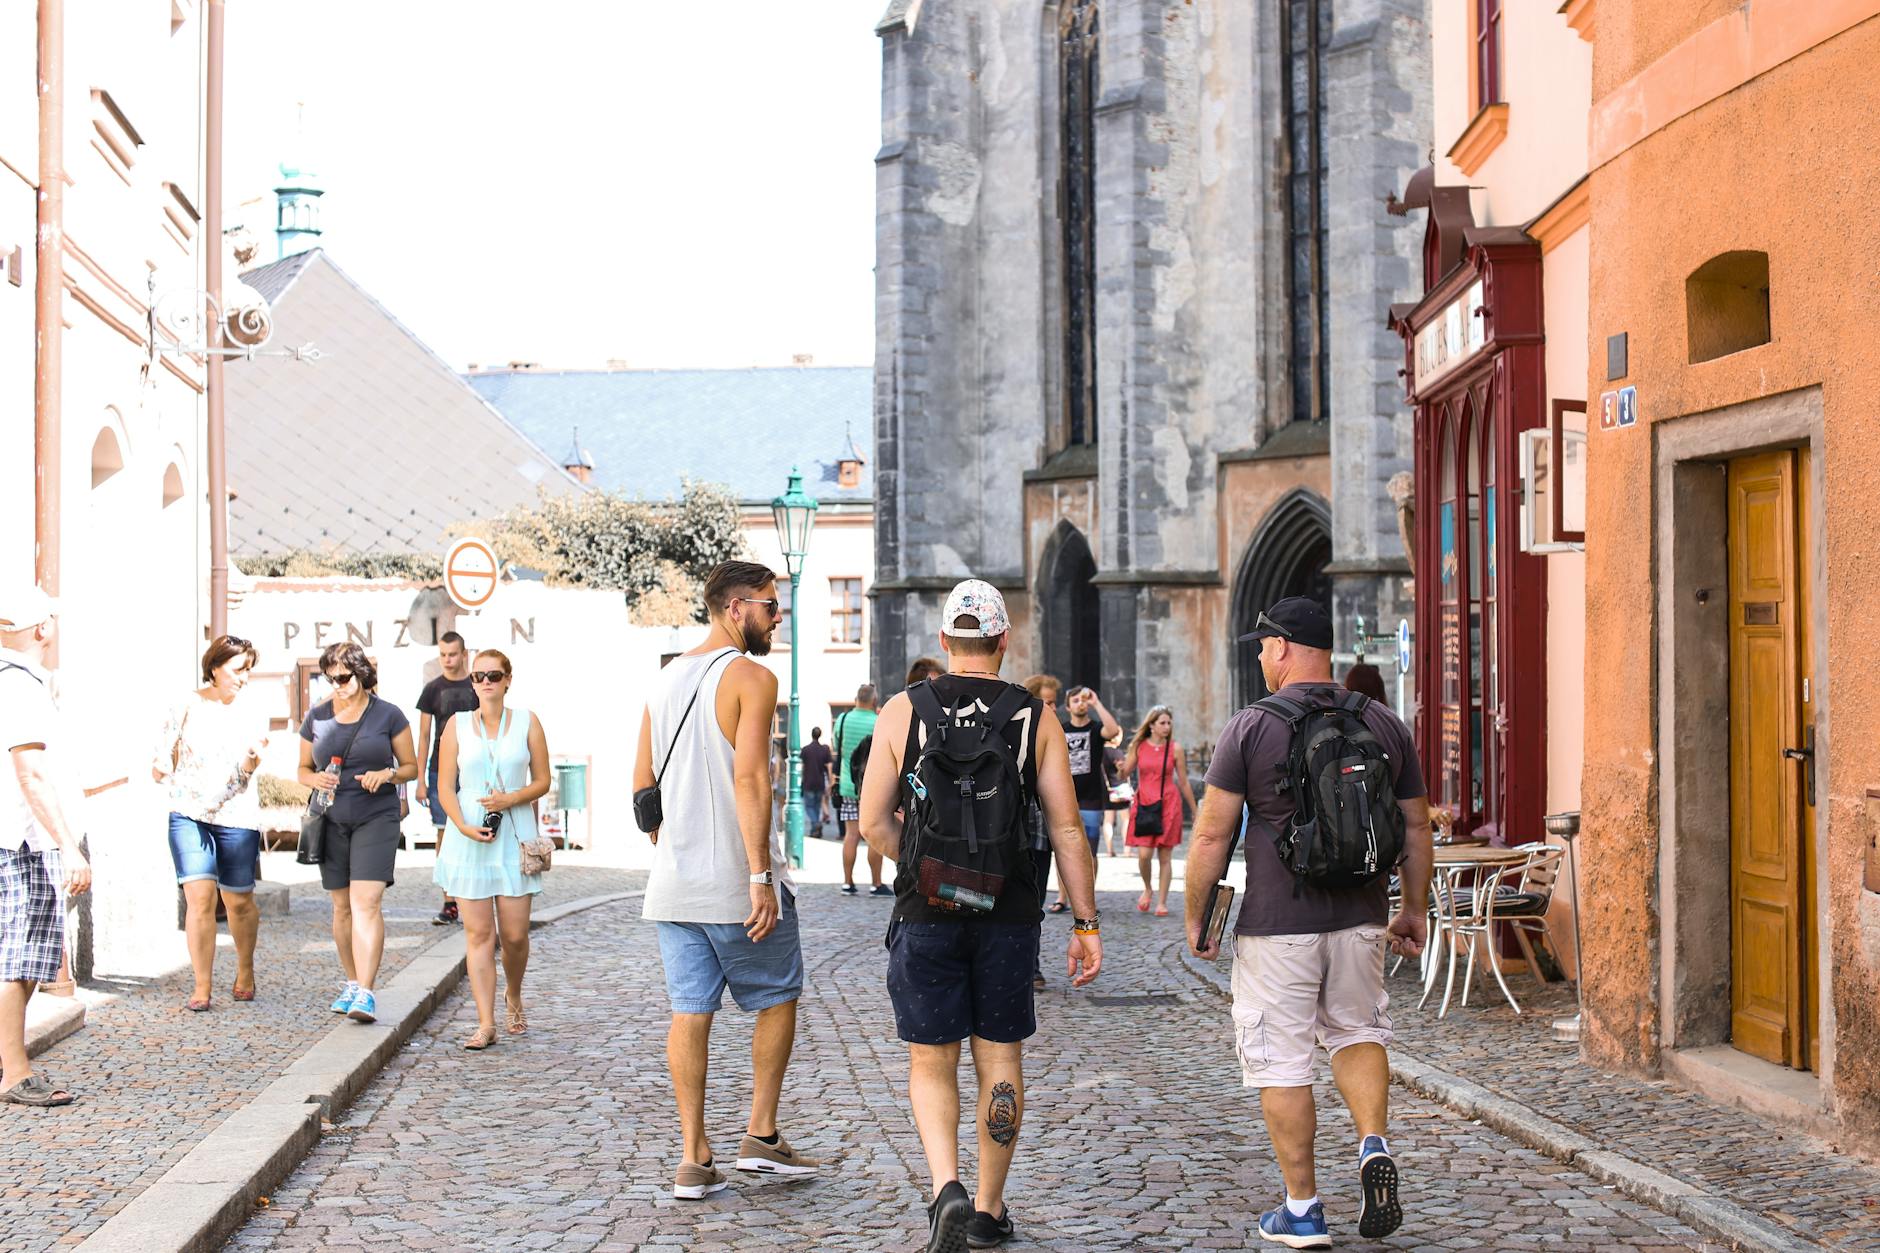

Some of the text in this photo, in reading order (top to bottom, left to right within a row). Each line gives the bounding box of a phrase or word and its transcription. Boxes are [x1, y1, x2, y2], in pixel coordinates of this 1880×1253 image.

[1420, 321, 1448, 378] BLUES
[1605, 398, 1611, 424] 5
[1623, 393, 1629, 420] 3
[283, 616, 535, 650] PENZIN
